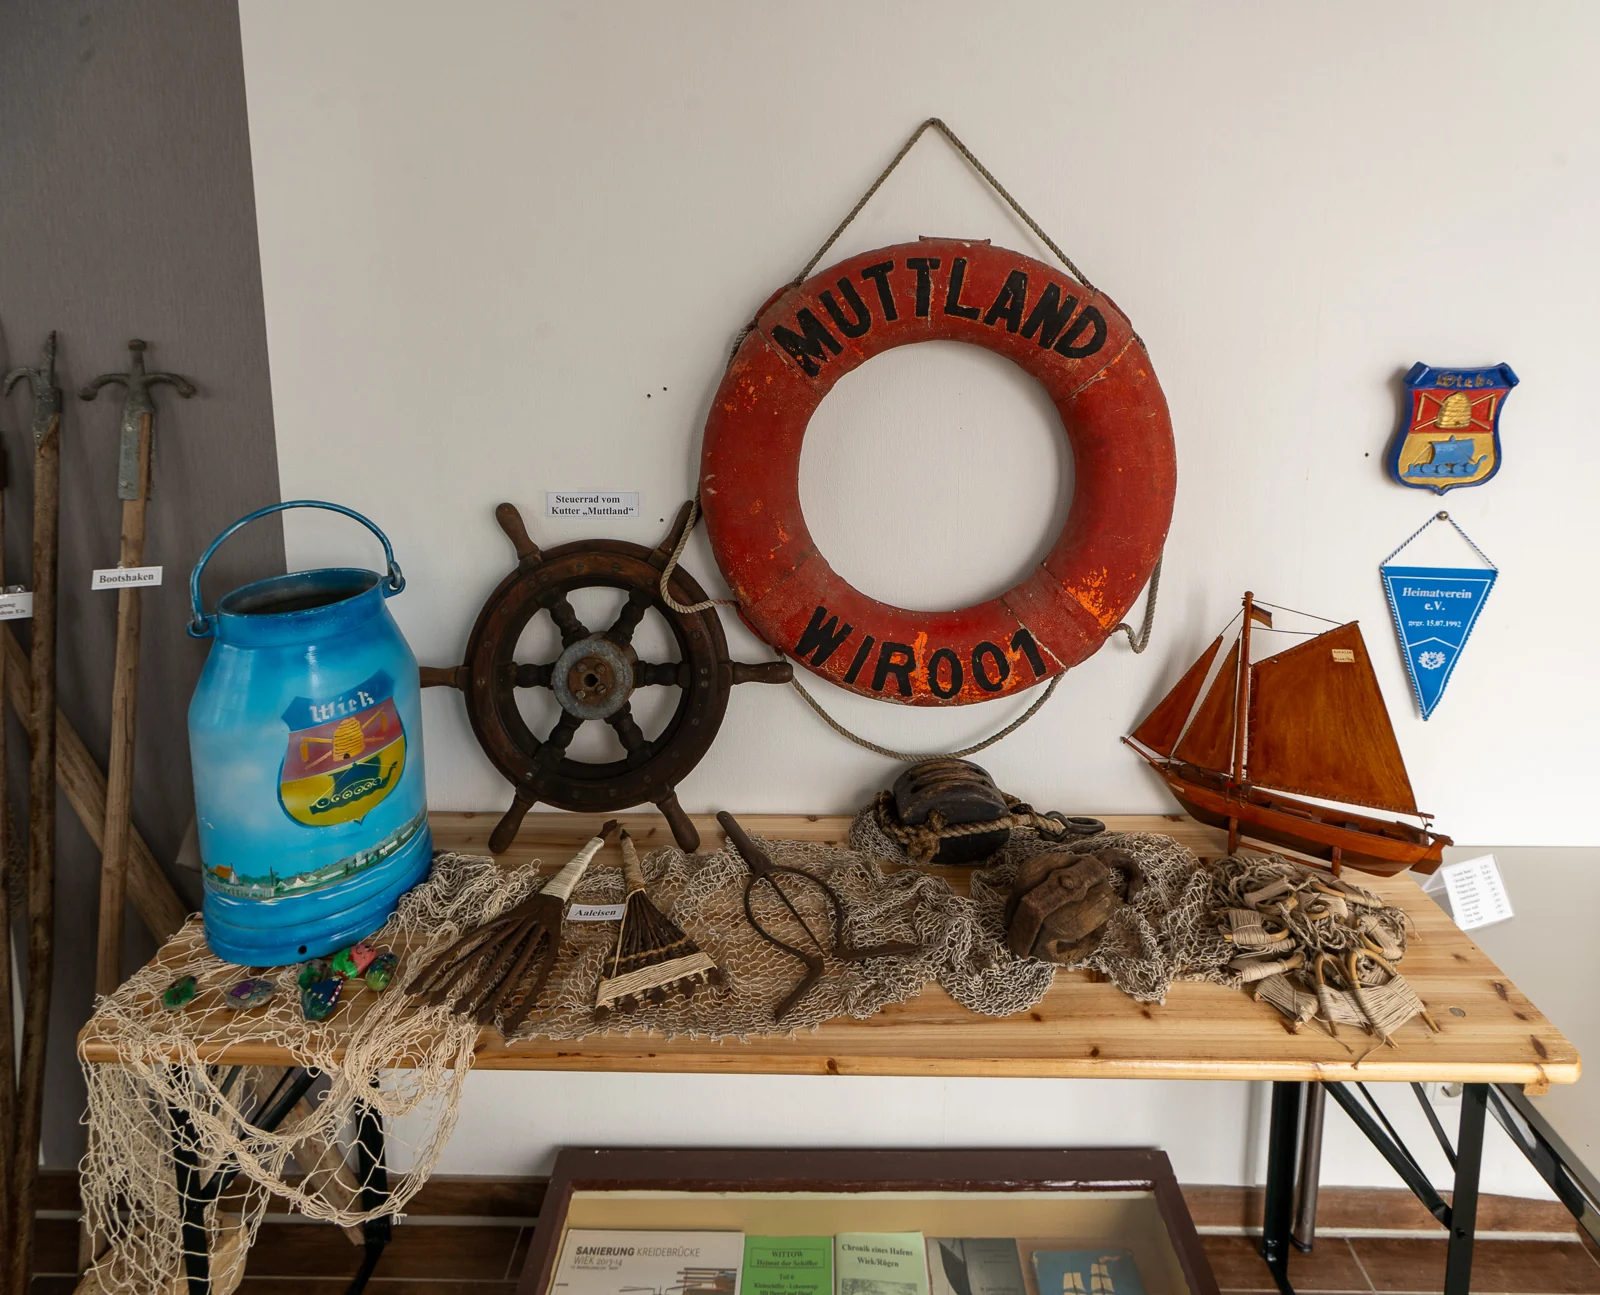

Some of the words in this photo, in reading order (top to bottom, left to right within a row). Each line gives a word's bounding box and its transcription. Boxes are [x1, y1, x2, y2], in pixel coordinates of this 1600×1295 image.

[770, 256, 1108, 377] MUTTLAND
[555, 495, 599, 503] Steuerrad
[551, 506, 580, 515] Kutter
[99, 573, 154, 584] Bootshaken
[1402, 587, 1472, 599] Heimatverein
[1424, 601, 1446, 611] e.V.
[1426, 619, 1462, 628] 15.07.1992
[575, 909, 616, 917] Aaleisen
[576, 1245, 635, 1257] SANIERUNG
[636, 1246, 701, 1258] KREIDEBRÜCKE
[771, 1250, 804, 1259] WITTOW
[841, 1243, 871, 1254] Chronik
[871, 1247, 889, 1255] eines
[889, 1247, 914, 1257] Hafens
[573, 1255, 594, 1266] WIEK
[756, 1259, 780, 1267] Heimat
[793, 1260, 819, 1268] Schiffer
[857, 1256, 900, 1269] Wiek/Rügen
